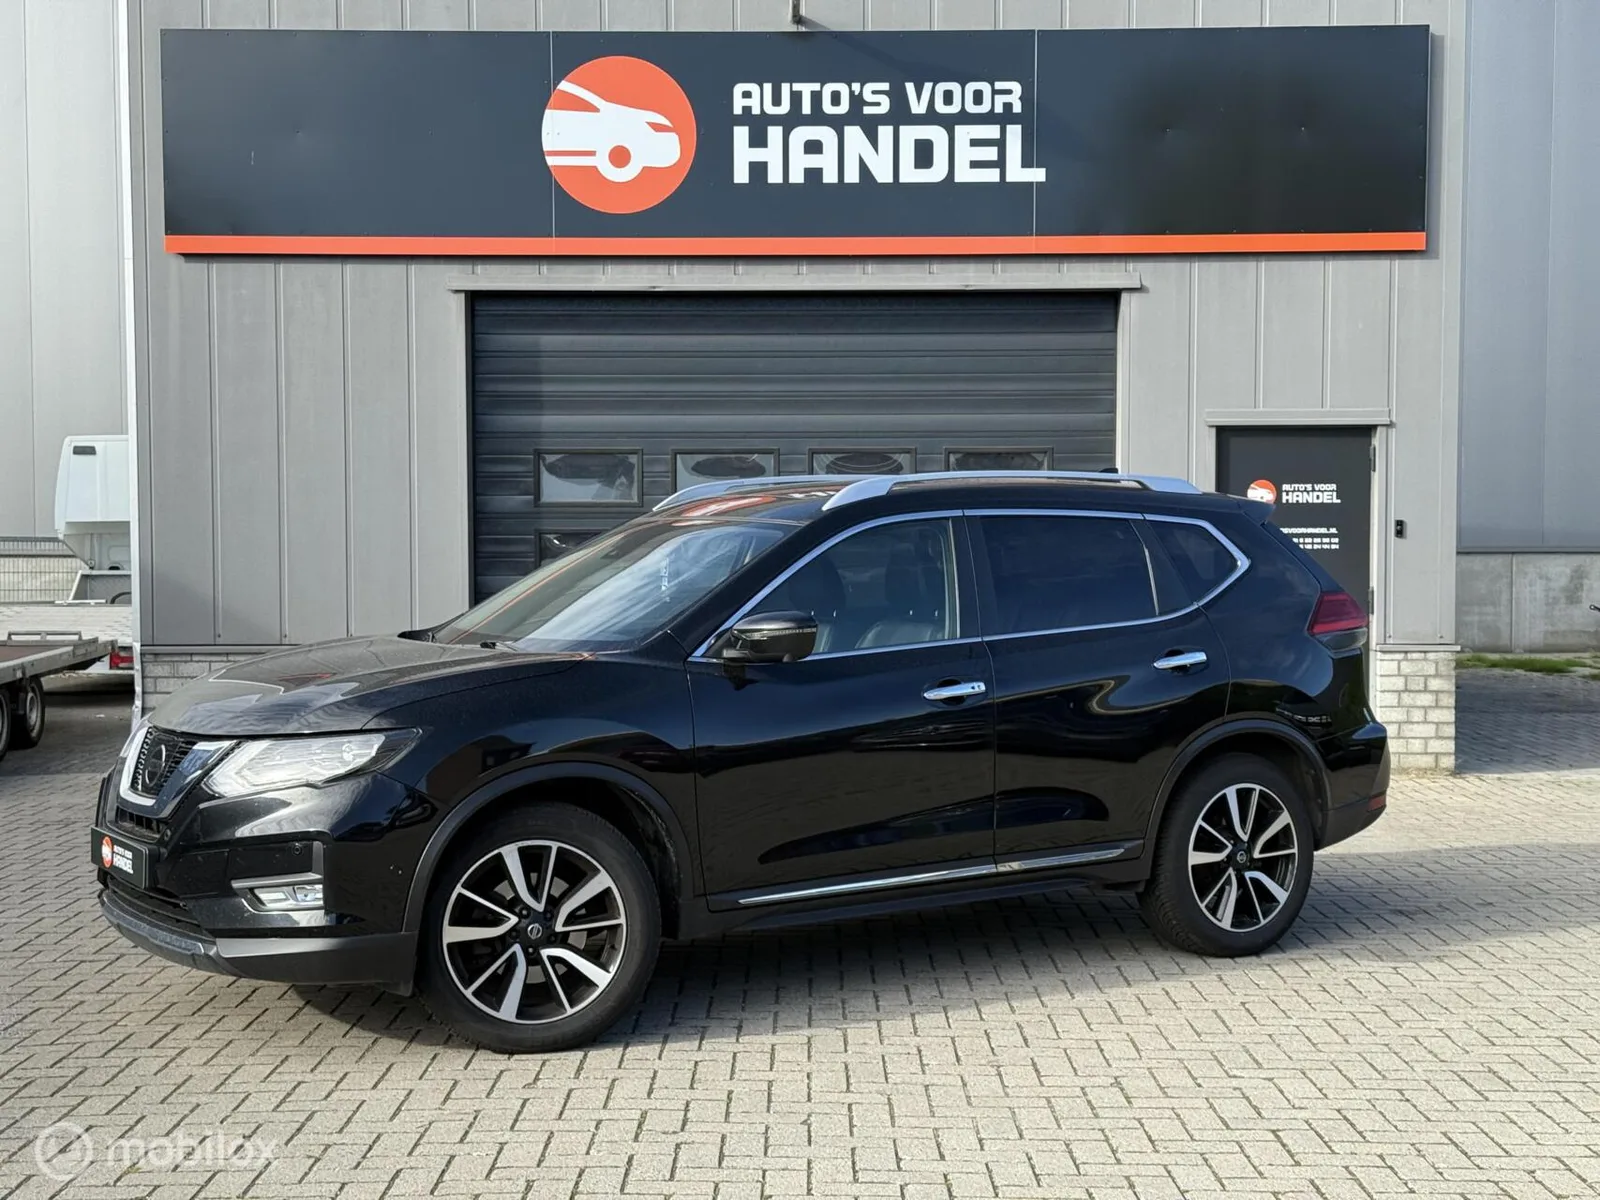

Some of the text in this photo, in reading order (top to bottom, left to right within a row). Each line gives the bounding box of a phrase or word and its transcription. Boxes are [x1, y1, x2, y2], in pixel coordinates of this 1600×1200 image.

[733, 81, 1022, 115] AUTO'S VOOR
[733, 124, 1047, 184] HANDEL
[1282, 491, 1341, 503] HANDEL
[1314, 483, 1336, 491] VOOR
